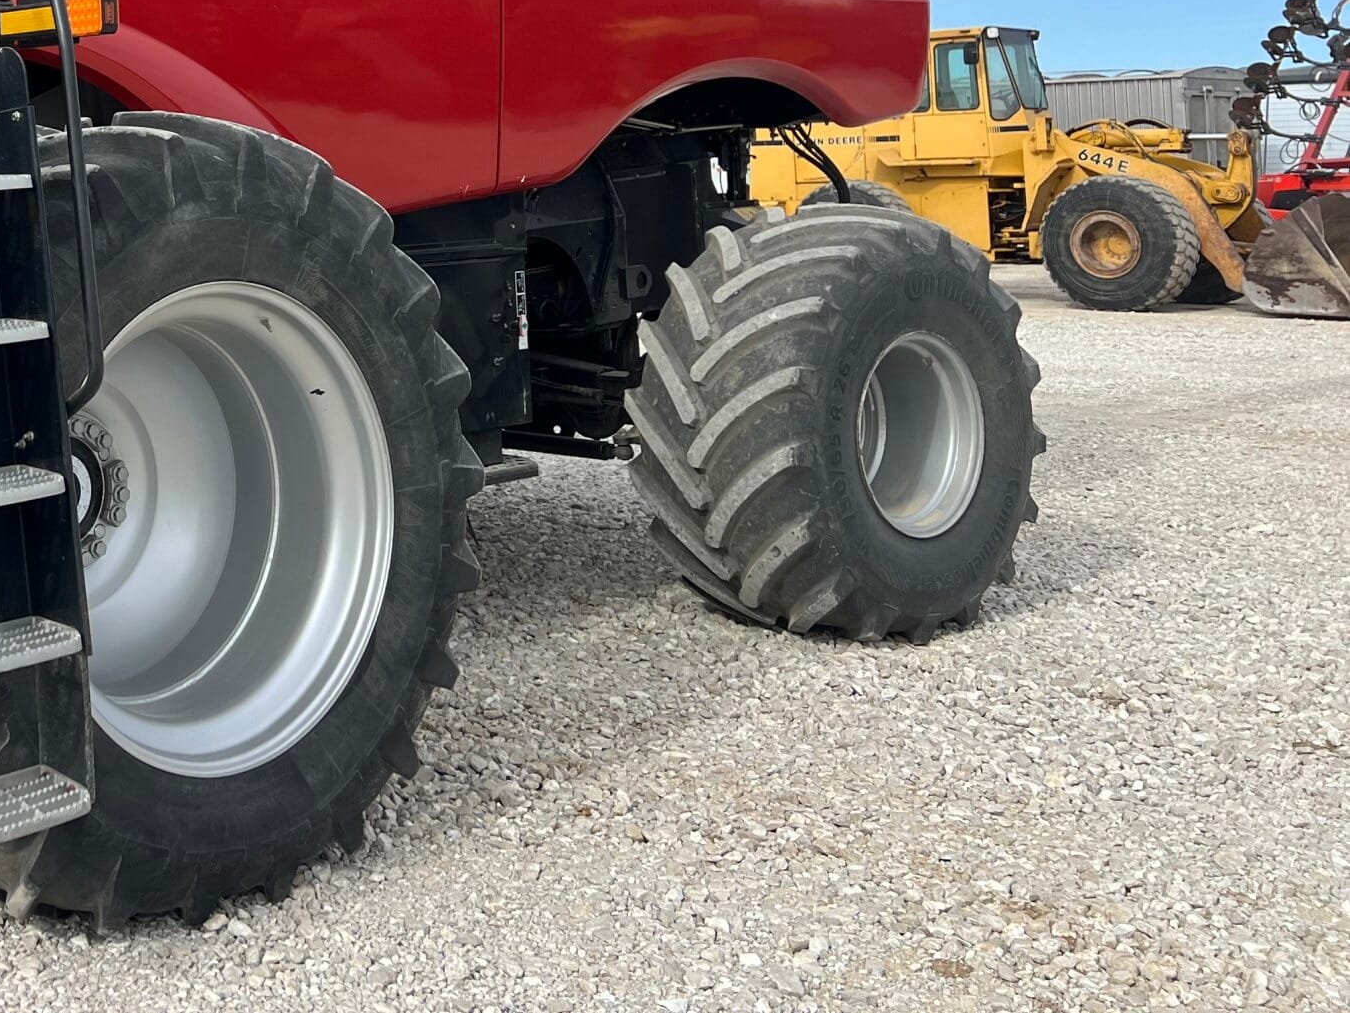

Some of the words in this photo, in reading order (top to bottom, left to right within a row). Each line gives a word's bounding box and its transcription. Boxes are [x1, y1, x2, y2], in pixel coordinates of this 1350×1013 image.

[828, 136, 862, 145] DEERE
[1078, 149, 1114, 169] 644
[1117, 159, 1129, 173] E
